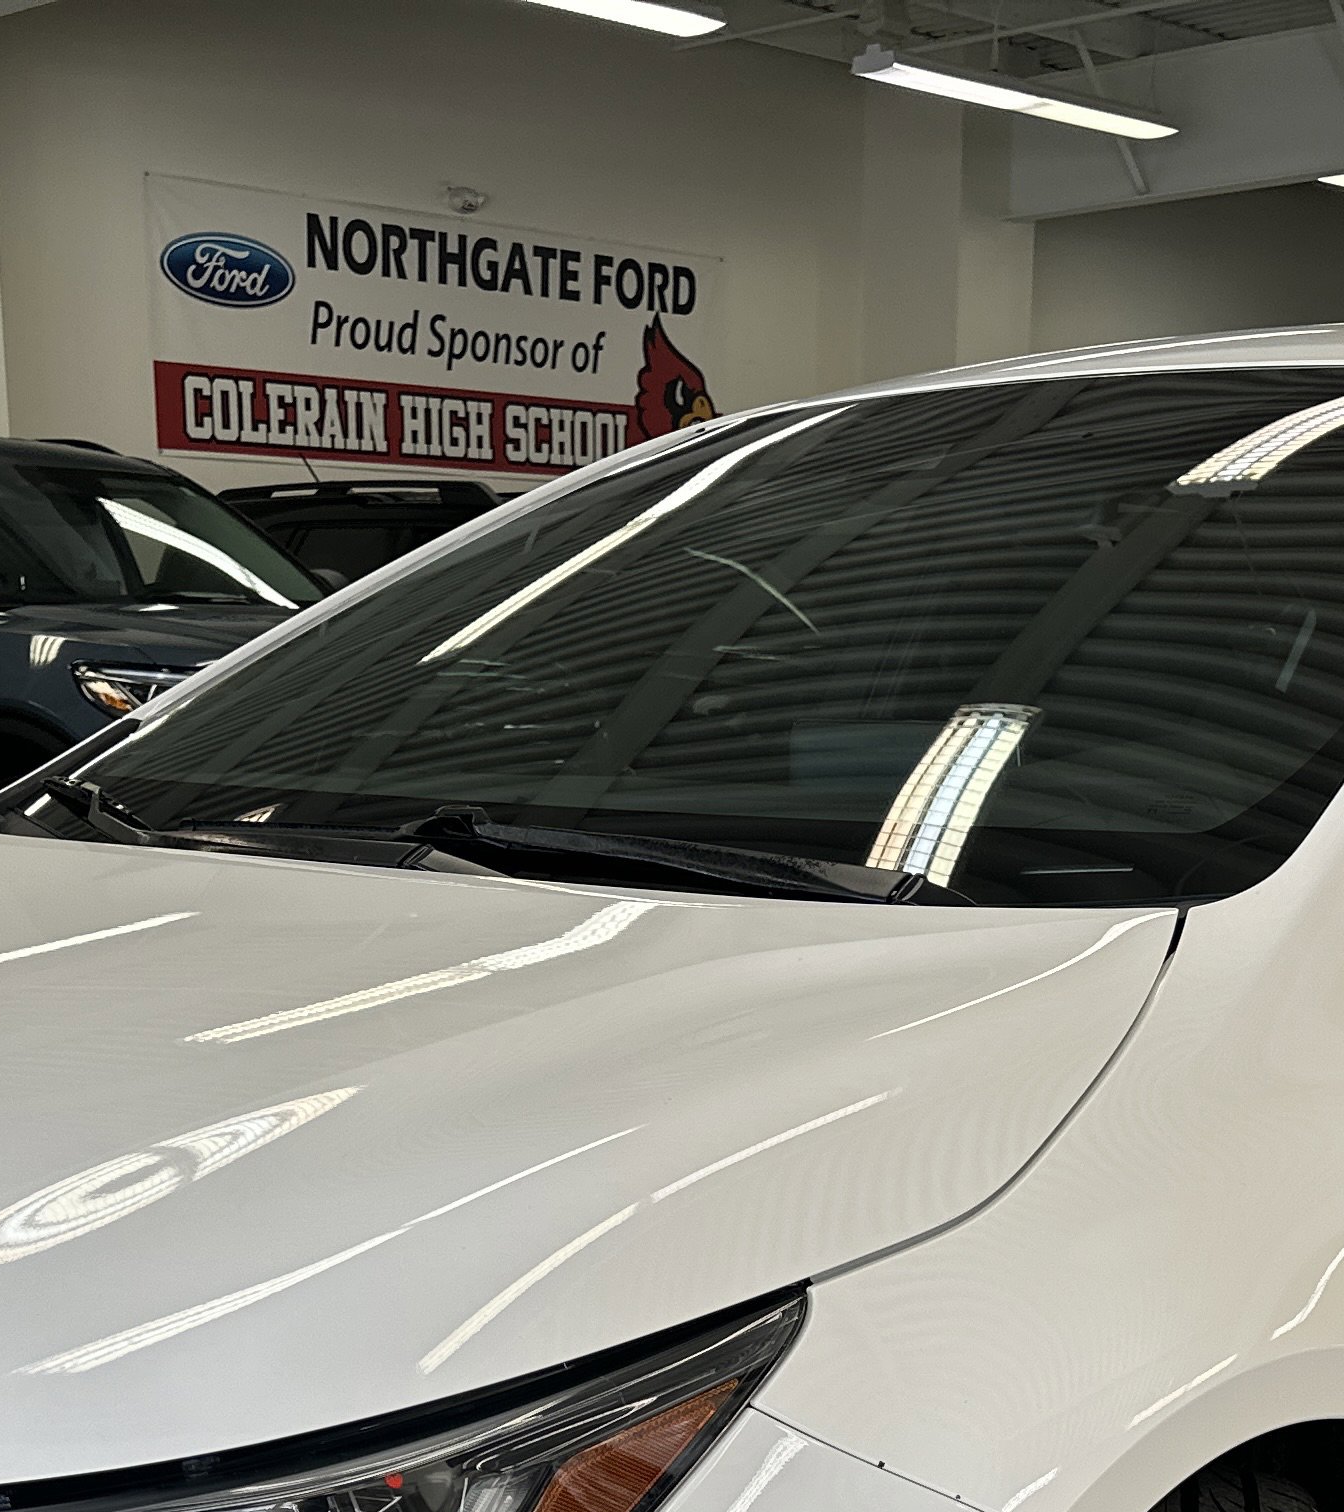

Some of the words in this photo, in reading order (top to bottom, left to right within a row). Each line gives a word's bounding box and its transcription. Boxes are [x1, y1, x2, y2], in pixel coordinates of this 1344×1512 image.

[186, 242, 272, 297] Ford
[306, 212, 581, 302] NORTHGATE
[592, 253, 697, 316] FORD
[310, 300, 420, 356] Proud
[426, 313, 565, 372] Sponsor
[571, 330, 606, 375] of
[182, 374, 388, 454] COLERAIN
[400, 394, 494, 461] HIGH
